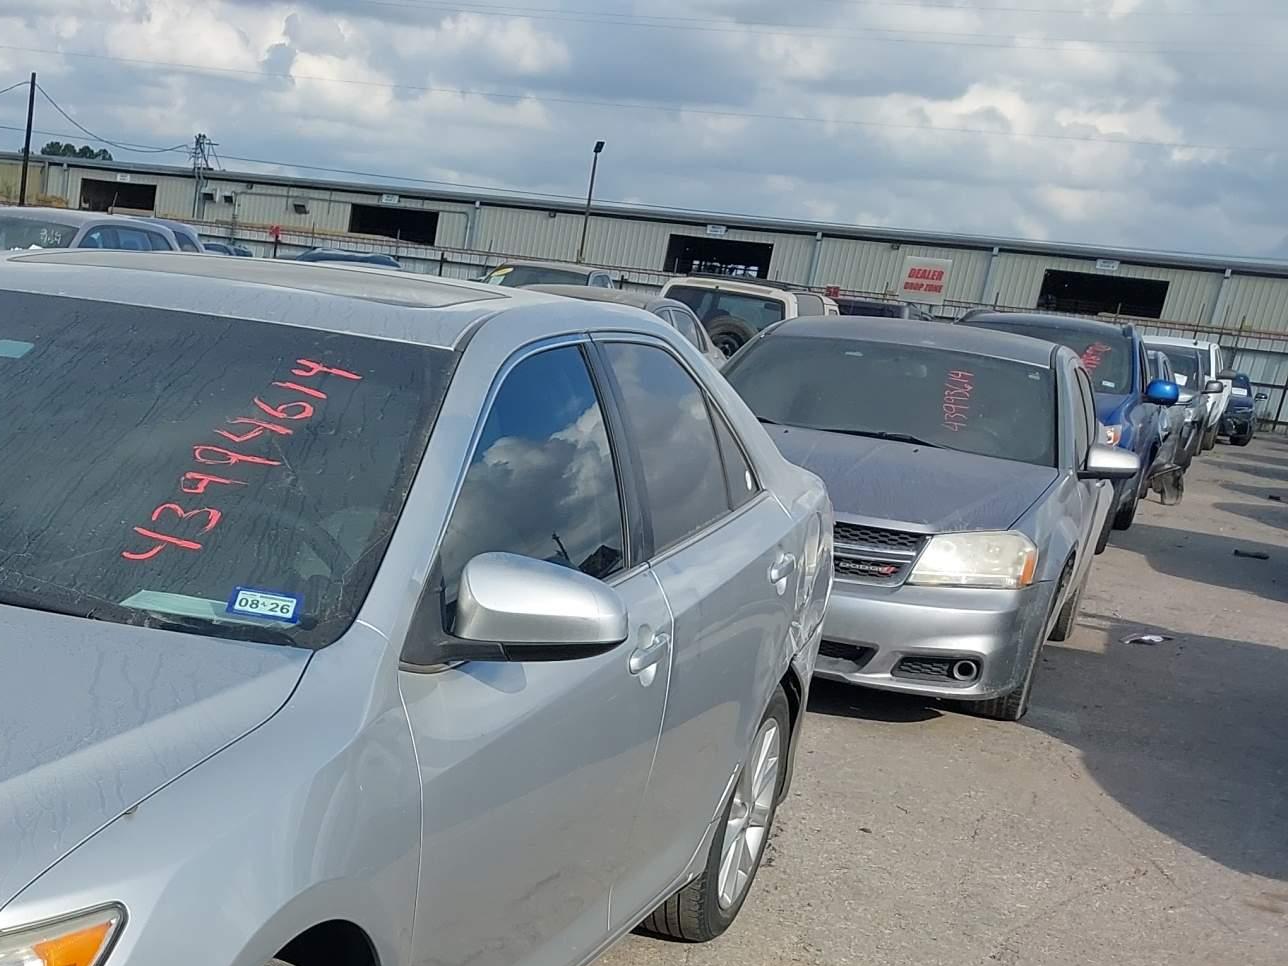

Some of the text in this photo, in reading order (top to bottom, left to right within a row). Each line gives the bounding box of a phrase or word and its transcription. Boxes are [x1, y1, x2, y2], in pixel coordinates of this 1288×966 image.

[908, 267, 944, 281] DEALER
[121, 357, 363, 561] 43994614
[839, 561, 886, 574] DODGE
